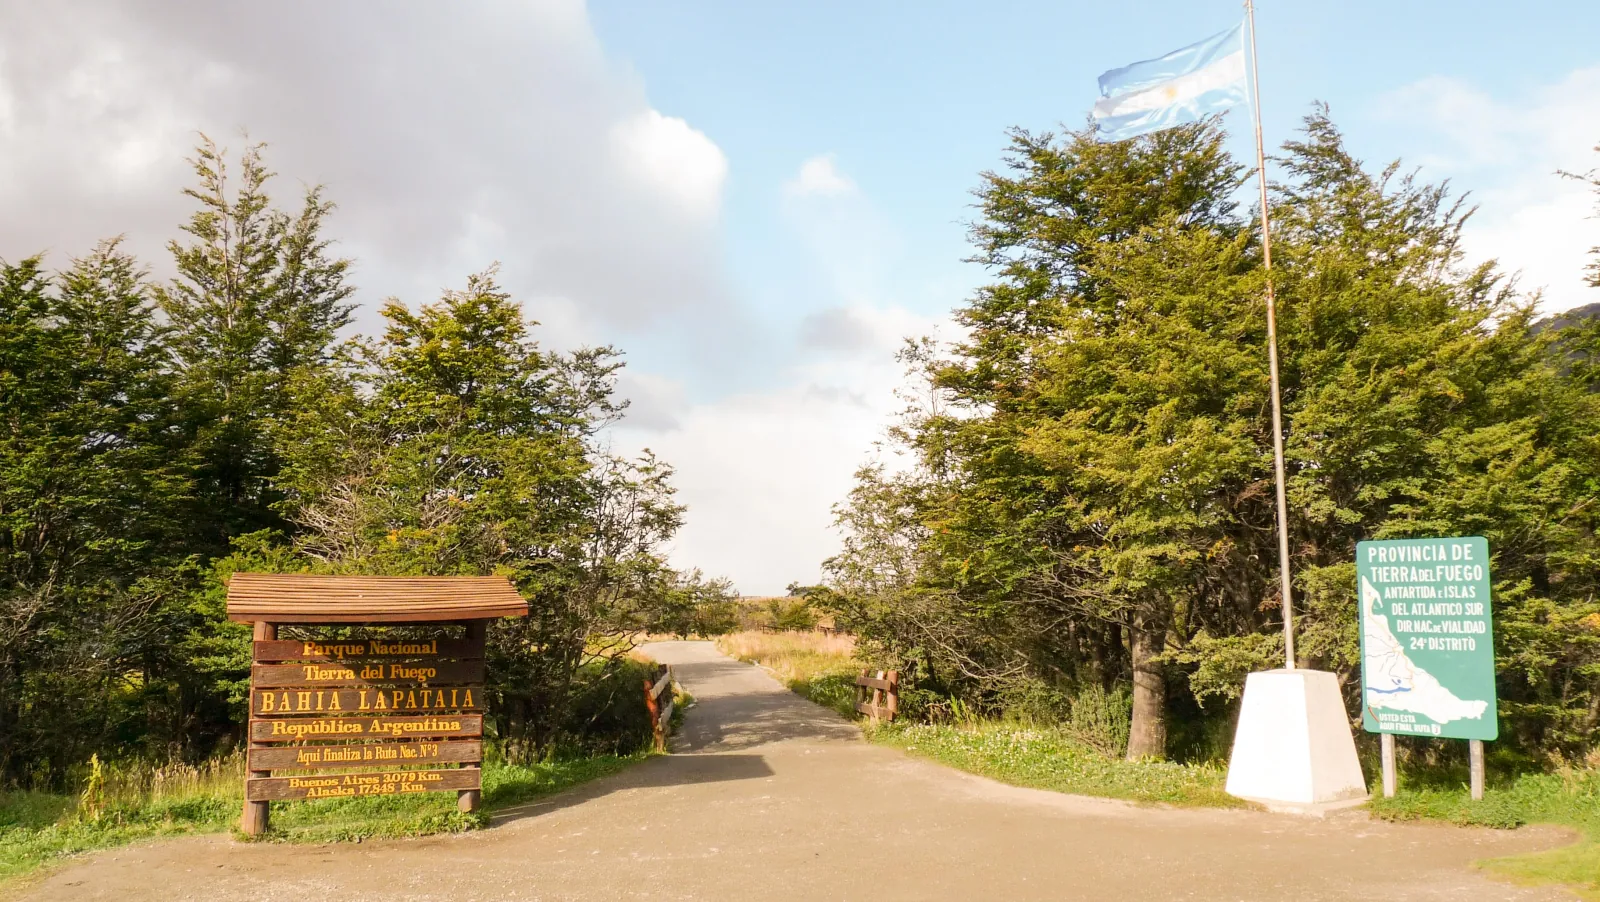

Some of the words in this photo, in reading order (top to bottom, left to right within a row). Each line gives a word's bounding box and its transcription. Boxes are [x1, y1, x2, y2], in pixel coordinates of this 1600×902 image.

[1368, 545, 1446, 563] PROVINCIA
[1452, 544, 1473, 561] DE
[1370, 566, 1419, 583] TIERRA
[1419, 569, 1436, 582] DEL
[1436, 565, 1483, 582] FUEGO
[1384, 586, 1436, 599] ANTARTIDA
[1444, 586, 1476, 598] ISLAS
[1392, 603, 1409, 615] DEL
[1411, 603, 1462, 616] ATLANTICO
[1465, 603, 1484, 616] SUR
[1441, 620, 1486, 634] VIALIDAD
[302, 641, 364, 659] Parque
[369, 640, 438, 655] Nacional
[302, 665, 355, 681] Tierra
[360, 665, 384, 679] del
[389, 664, 436, 682] Fuego
[260, 691, 342, 713] BAHIA
[358, 689, 475, 711] LAPATAIA
[271, 720, 363, 738] República
[368, 718, 462, 736] Argentina
[322, 747, 361, 762] finaliza
[363, 747, 373, 760] la
[375, 746, 397, 759] Ruta
[289, 778, 339, 788] Buenos
[342, 775, 380, 786] Aires
[417, 772, 444, 782] Km.
[306, 786, 355, 797] Alaska
[401, 782, 426, 792] Km.
